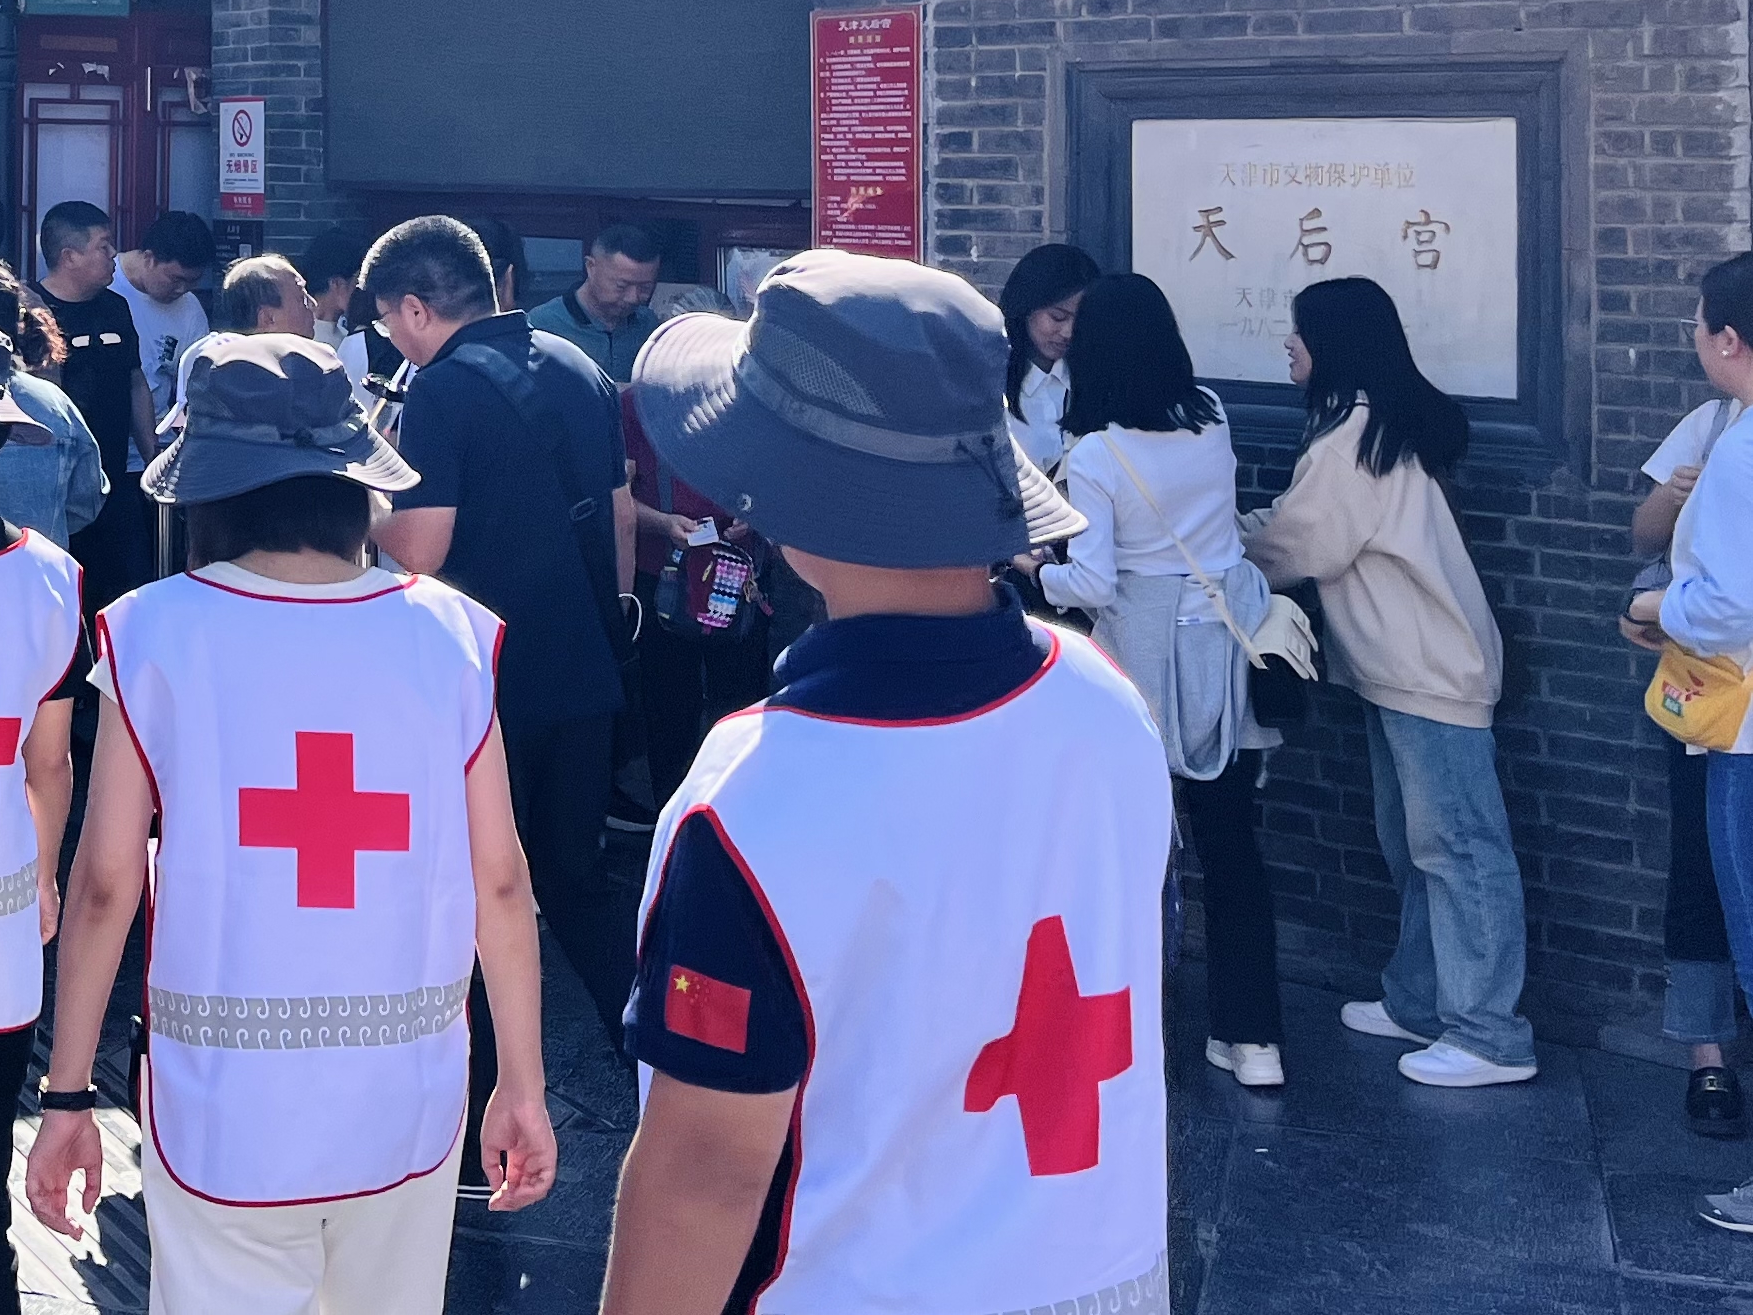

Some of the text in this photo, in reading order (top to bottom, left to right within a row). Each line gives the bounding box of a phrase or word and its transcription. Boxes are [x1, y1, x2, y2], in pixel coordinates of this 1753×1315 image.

[226, 159, 258, 174] 无烟景区
[1217, 161, 1416, 190] 天津市文物保护单位
[1188, 205, 1451, 271] 天后宫
